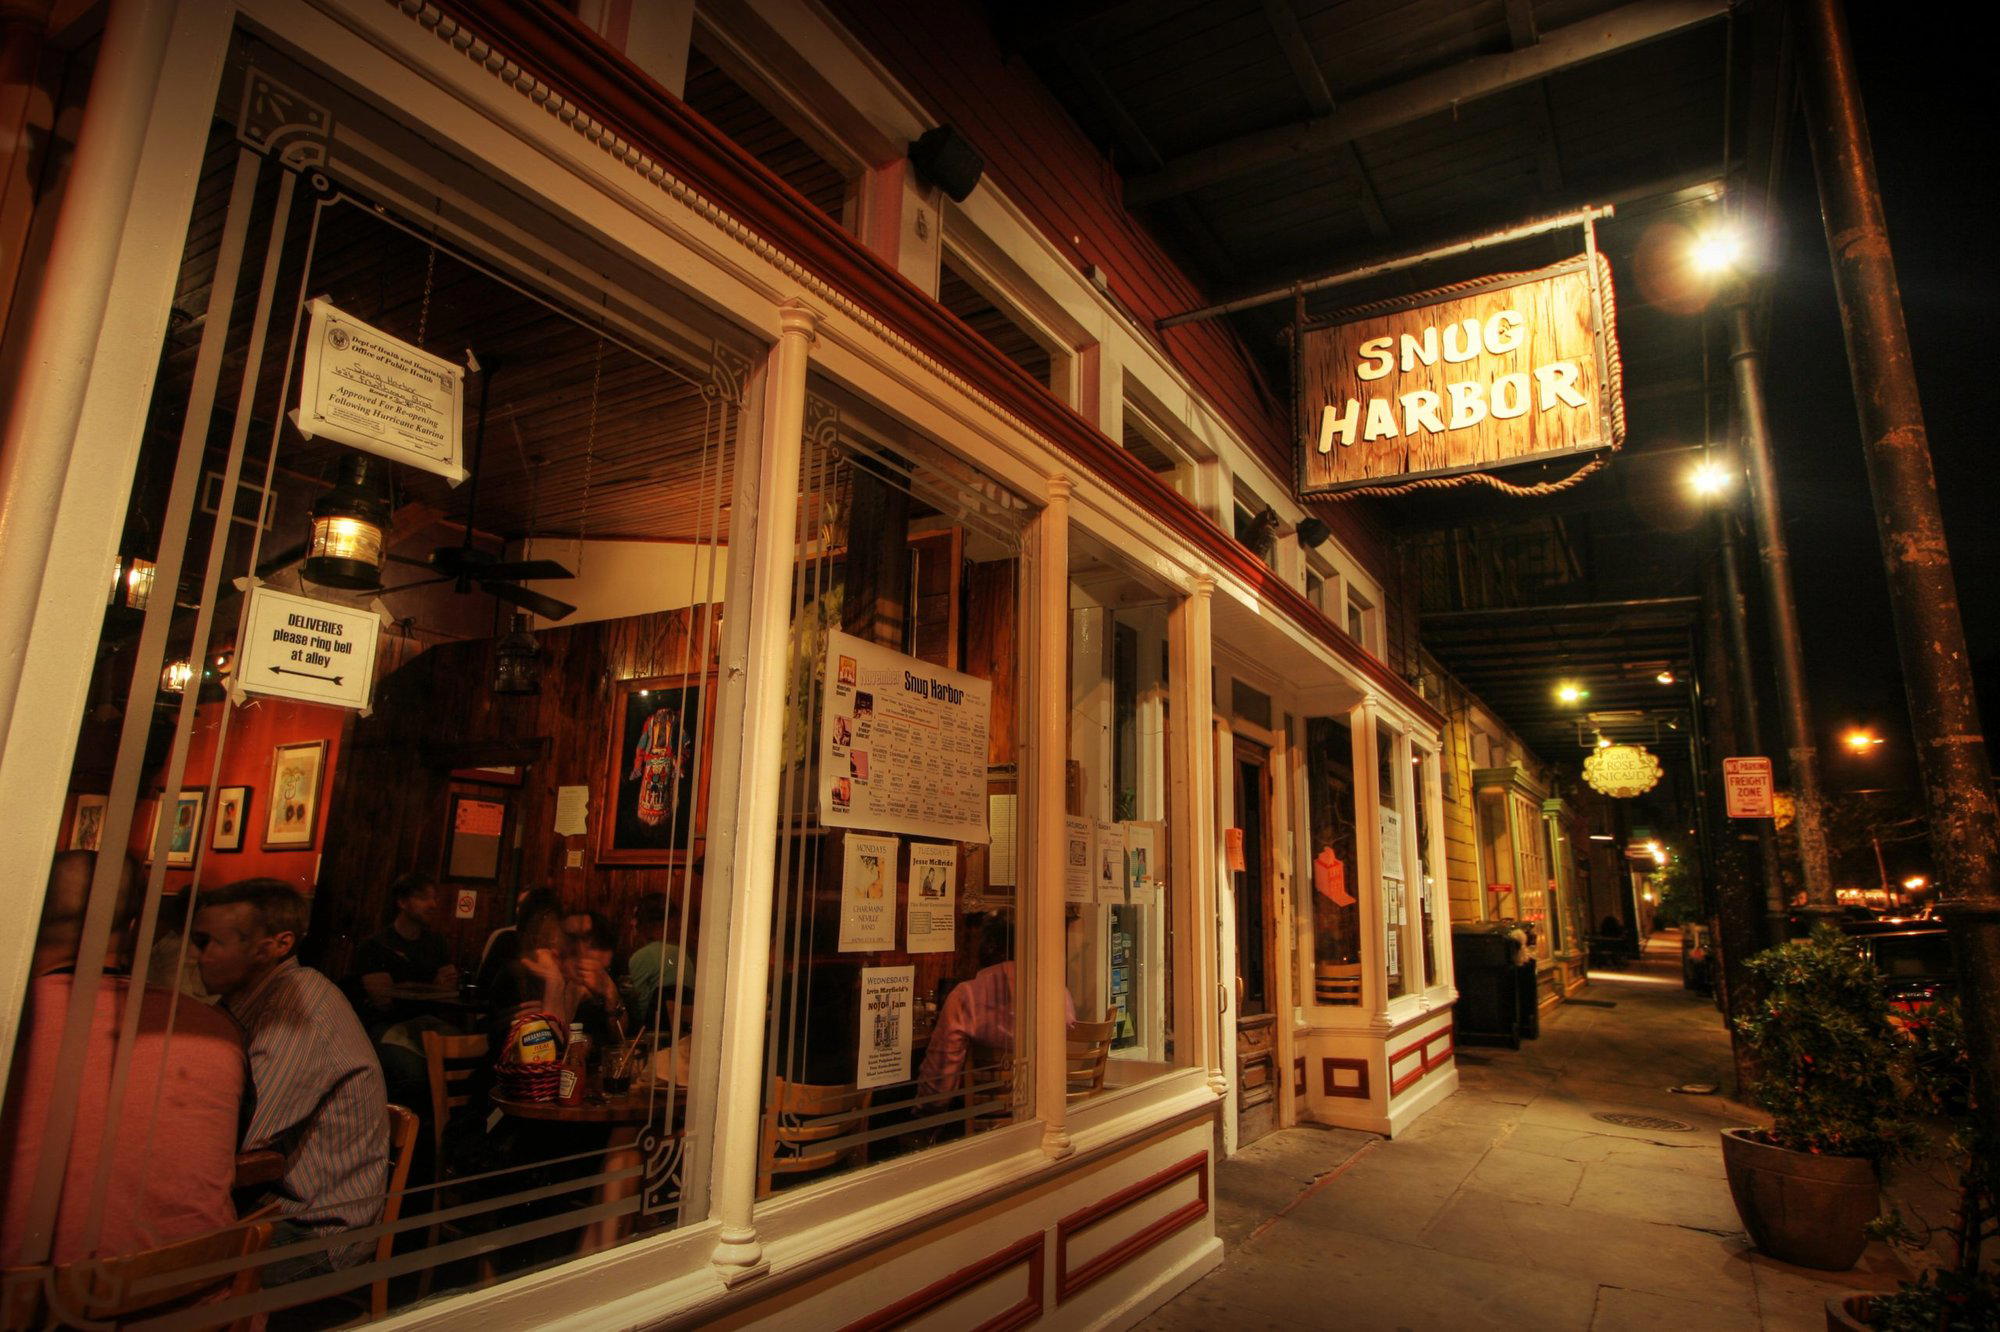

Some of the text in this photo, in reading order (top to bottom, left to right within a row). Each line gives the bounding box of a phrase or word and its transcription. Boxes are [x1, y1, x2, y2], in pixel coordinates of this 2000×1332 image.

[1357, 309, 1525, 381] SNUG
[351, 345, 375, 358] Office
[385, 357, 409, 372] Public
[409, 368, 434, 383] Health
[377, 345, 400, 360] Health
[400, 356, 413, 365] and
[413, 362, 442, 379] Hospitals
[328, 393, 372, 416] Following
[372, 408, 415, 430] Hurricane
[415, 424, 445, 441] Katrina
[336, 386, 378, 405] Approved
[379, 399, 394, 411] For
[395, 405, 440, 429] Re-opening
[1318, 362, 1587, 454] HARBOR
[288, 613, 344, 636] DELIVERIES
[272, 629, 353, 655] please ring bell
[291, 649, 331, 669] at alley
[904, 670, 928, 700] Snug
[930, 679, 965, 706] Harbor
[1607, 761, 1636, 770] ROSE
[1729, 776, 1767, 786] FREIGHT
[1737, 787, 1763, 797] ZONE
[856, 843, 888, 854] MONDAYS
[912, 857, 954, 867] Jesse McBride
[867, 976, 909, 985] WEDNESDAYS
[892, 1000, 906, 1009] Jam
